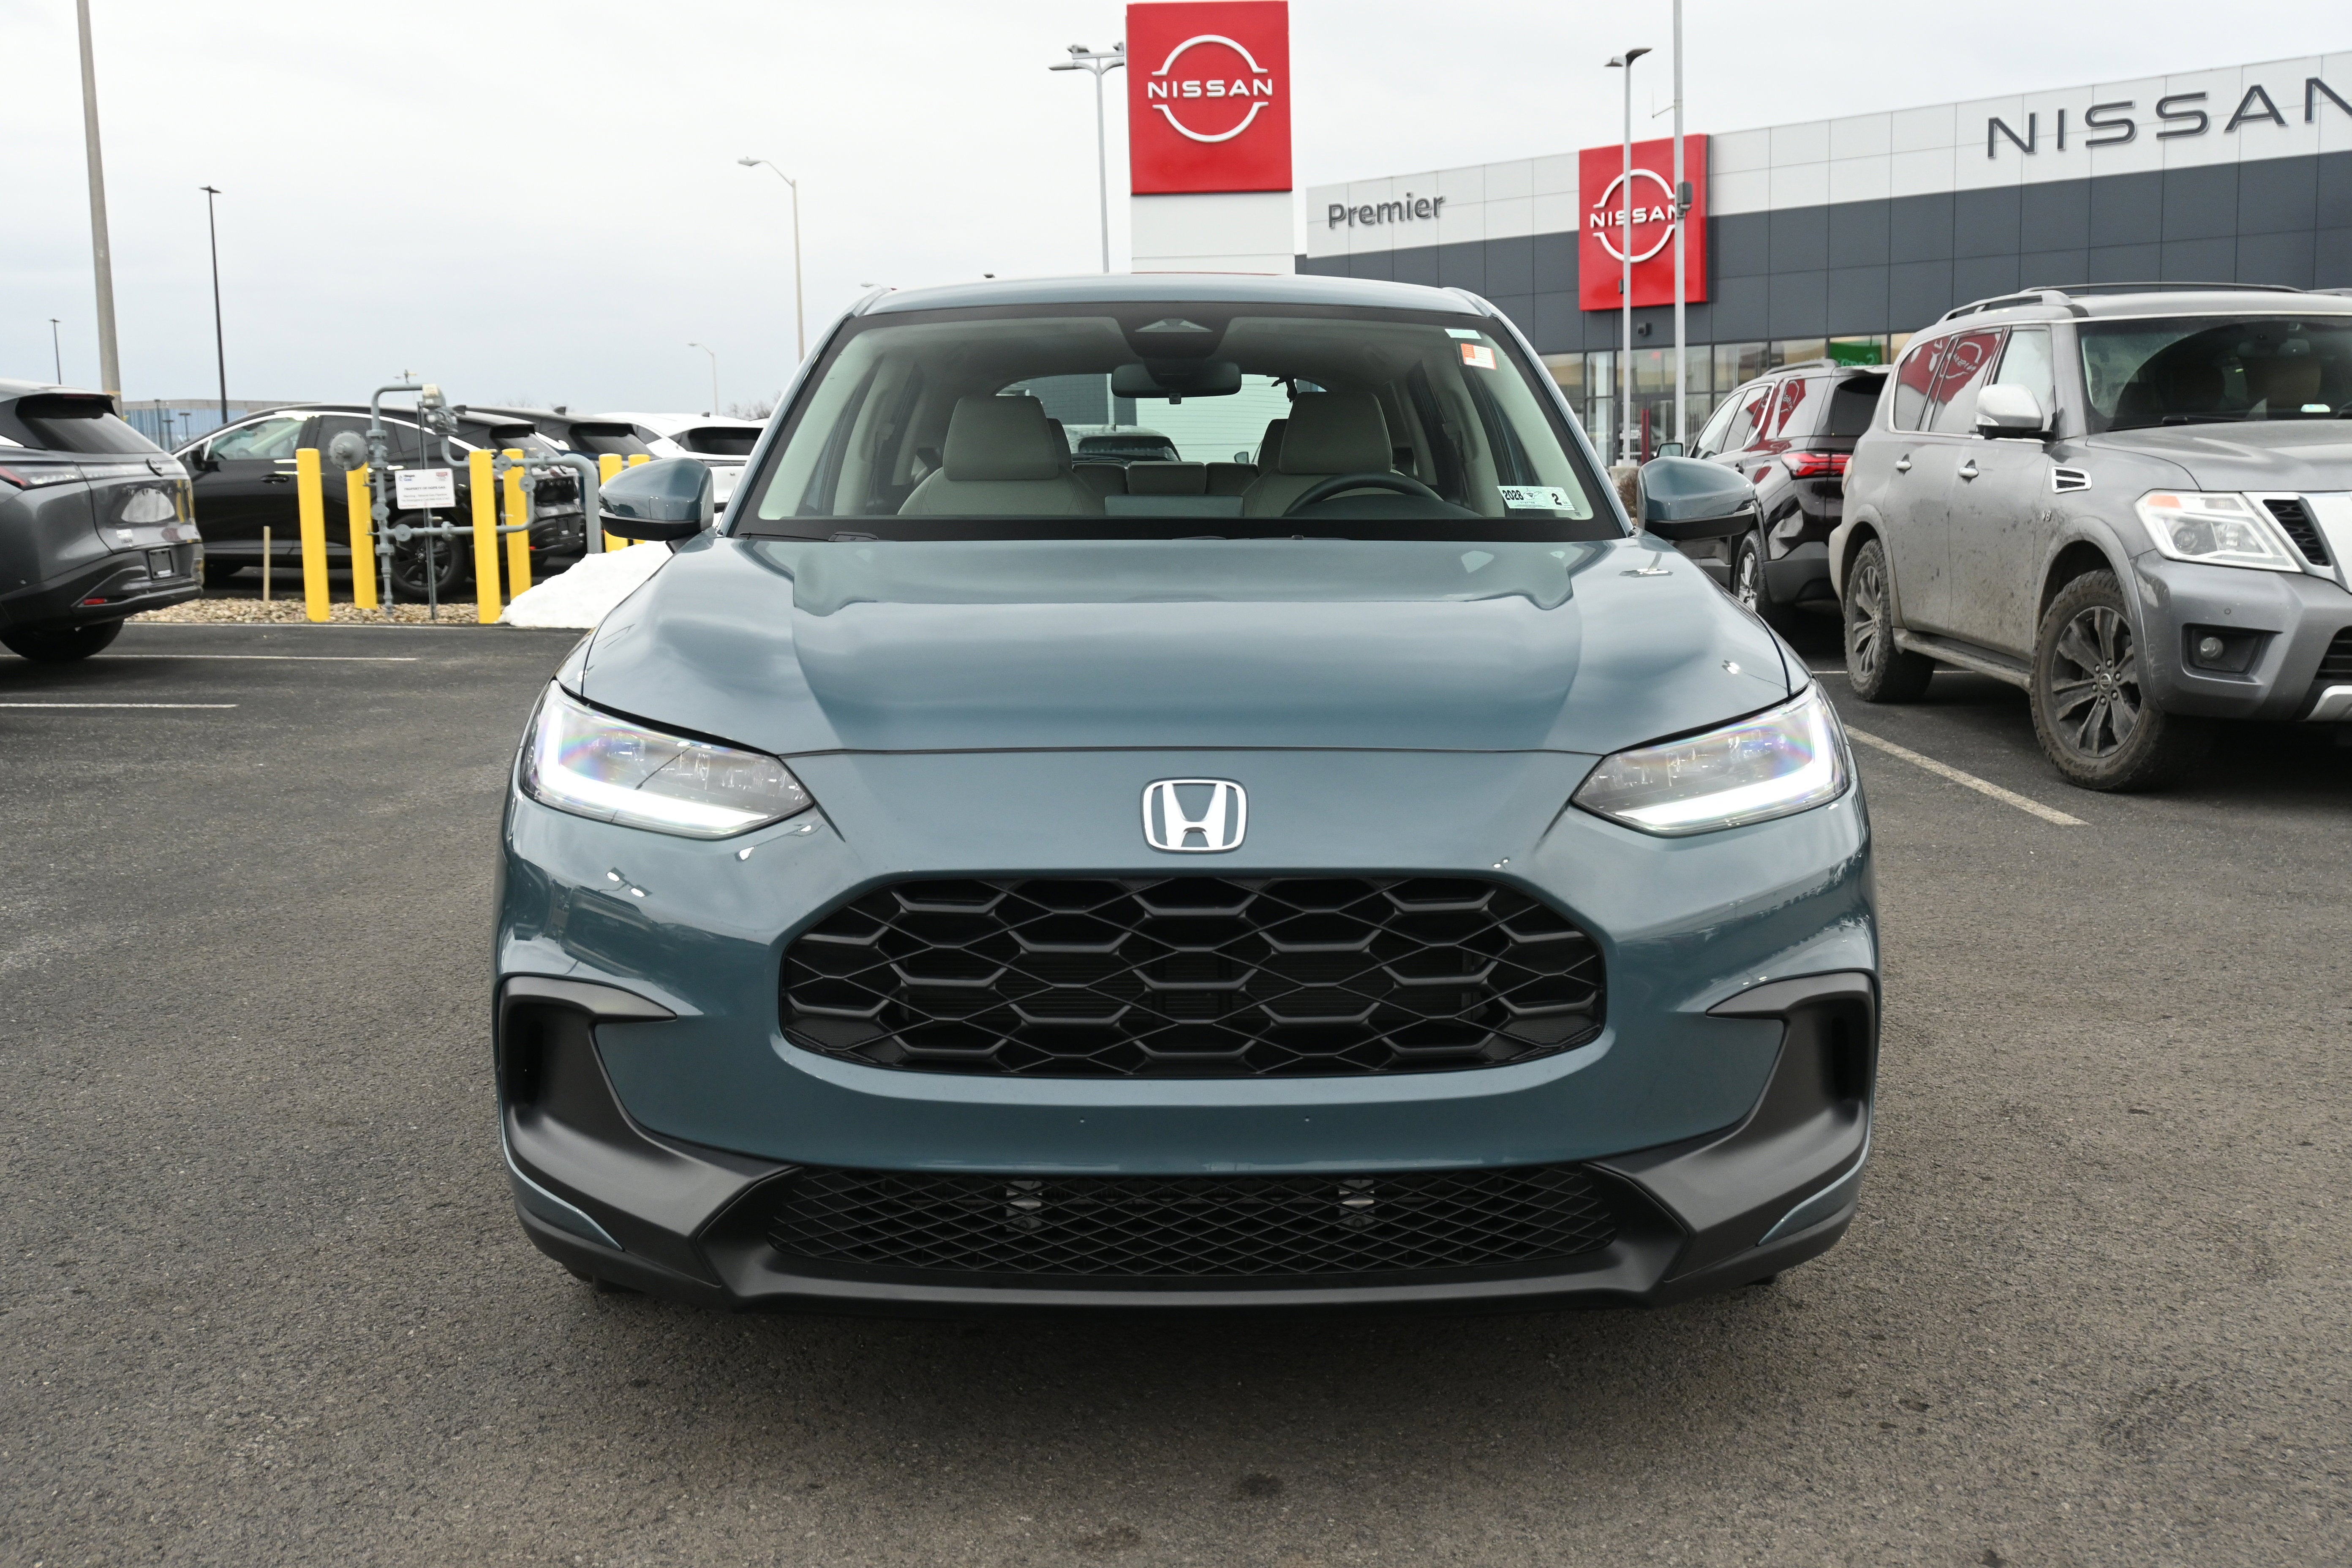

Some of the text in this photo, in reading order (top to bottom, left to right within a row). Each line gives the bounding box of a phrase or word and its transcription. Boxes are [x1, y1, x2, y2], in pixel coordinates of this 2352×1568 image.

[1147, 79, 1273, 99] NISSAN
[1987, 77, 2352, 159] NISSAN
[1328, 192, 1445, 229] Premier
[1502, 490, 1562, 506] 2028 2
[2042, 510, 2052, 522] V8
